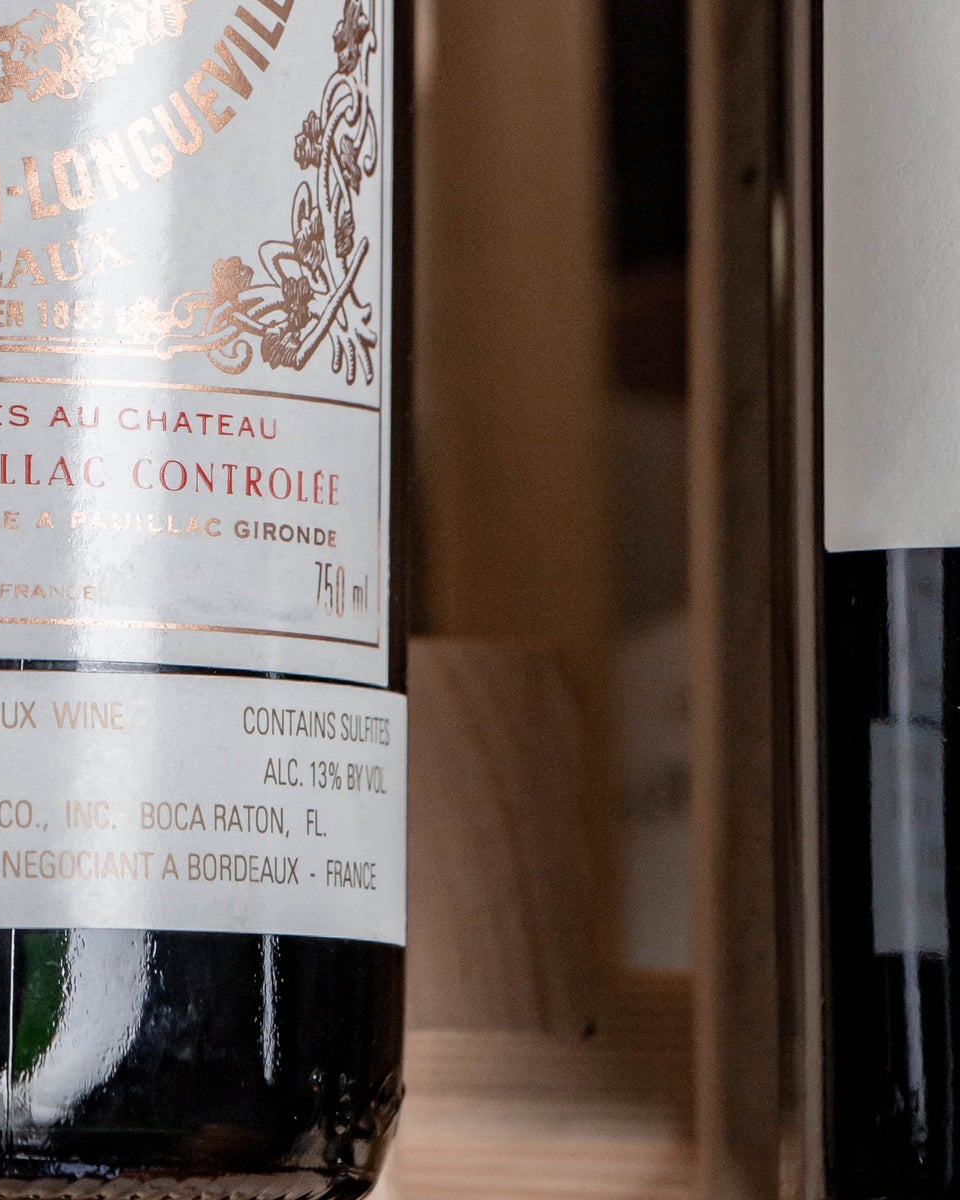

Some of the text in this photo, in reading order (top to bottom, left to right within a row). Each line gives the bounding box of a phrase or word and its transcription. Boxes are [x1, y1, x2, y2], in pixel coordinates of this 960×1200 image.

[48, 405, 100, 428] AU
[117, 408, 278, 440] CHATEAU
[132, 457, 341, 507] CONTROLÉE
[36, 511, 55, 528] A
[70, 511, 222, 537] PAUILLAC
[234, 520, 337, 548] GIRONDE
[0, 583, 96, 601] FRANCE
[314, 561, 369, 618] 750 ml
[53, 701, 124, 730] WINE
[243, 706, 390, 746] CONTAINS SULFITES
[263, 757, 303, 787] ALC.
[310, 761, 342, 790] 13%
[347, 763, 364, 791] BY
[66, 800, 117, 830] INC.
[140, 801, 206, 832] BOCA
[213, 803, 290, 838] RATON,
[306, 808, 327, 837] FL.
[1, 850, 154, 881] NEGOCIANT
[161, 852, 179, 880] A
[189, 853, 299, 885] BORDEAUX
[326, 859, 377, 890] FRANCE
